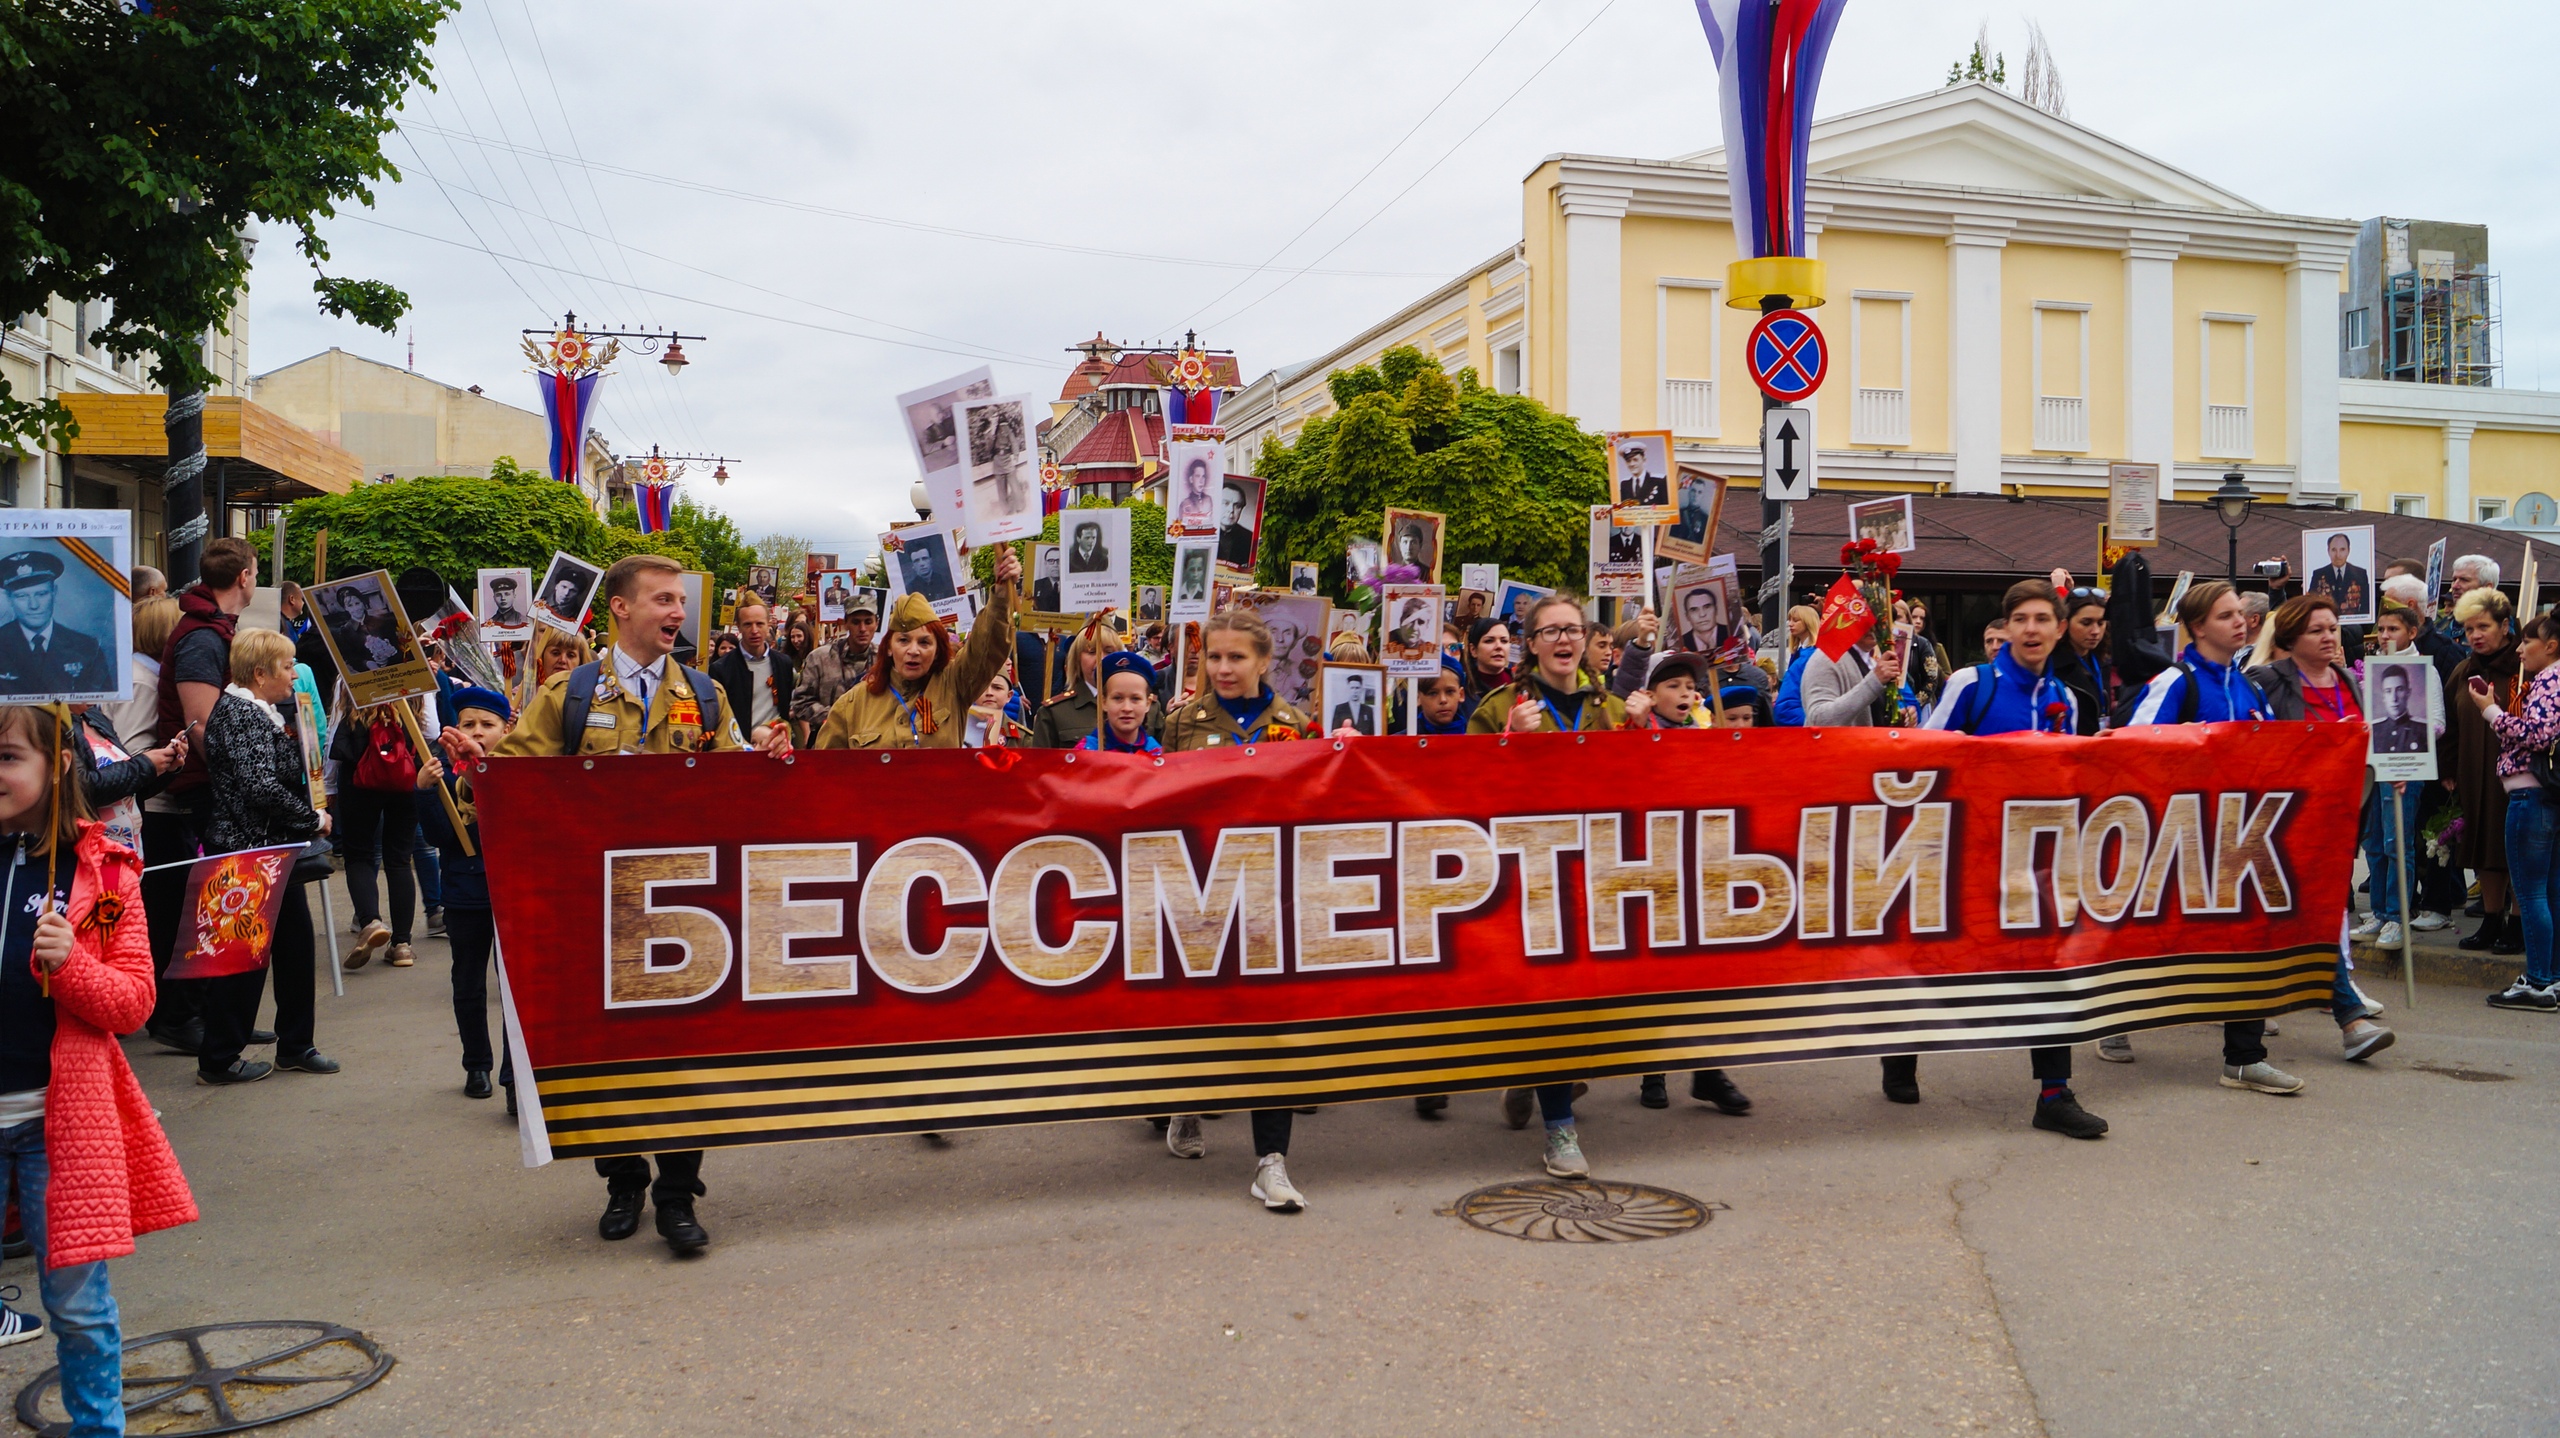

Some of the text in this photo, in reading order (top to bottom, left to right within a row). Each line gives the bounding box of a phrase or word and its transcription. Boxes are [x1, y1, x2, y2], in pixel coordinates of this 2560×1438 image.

[0, 522, 49, 530] ТЕРАН
[935, 607, 953, 615] АЕВИЧ
[372, 667, 399, 677] Попова
[349, 667, 429, 689] Бронислава Иосифовна
[603, 770, 2294, 1010] БЕССМЕРТНЫЙ ПОЛК
